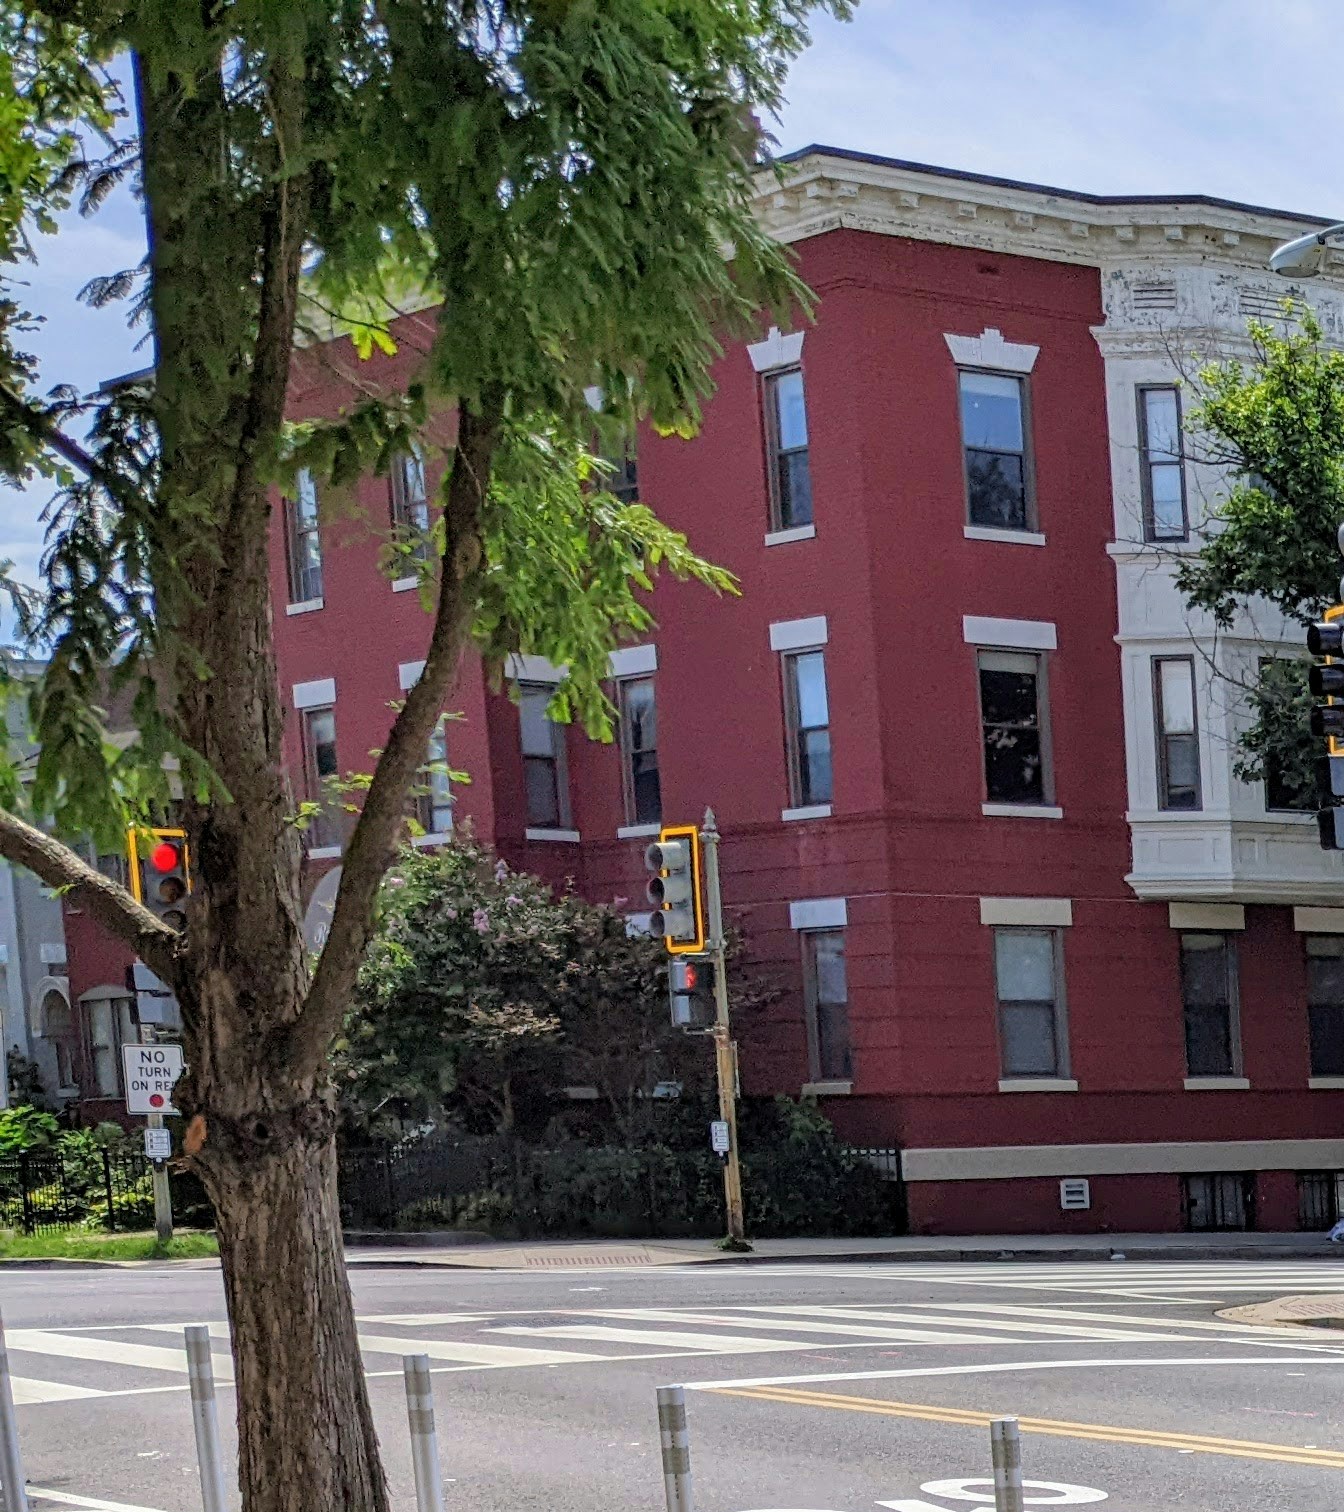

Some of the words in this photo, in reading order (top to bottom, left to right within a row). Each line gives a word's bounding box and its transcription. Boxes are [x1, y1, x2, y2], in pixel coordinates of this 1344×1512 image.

[140, 1050, 165, 1064] NO
[138, 1066, 171, 1078] TURN
[132, 1080, 149, 1092] ON
